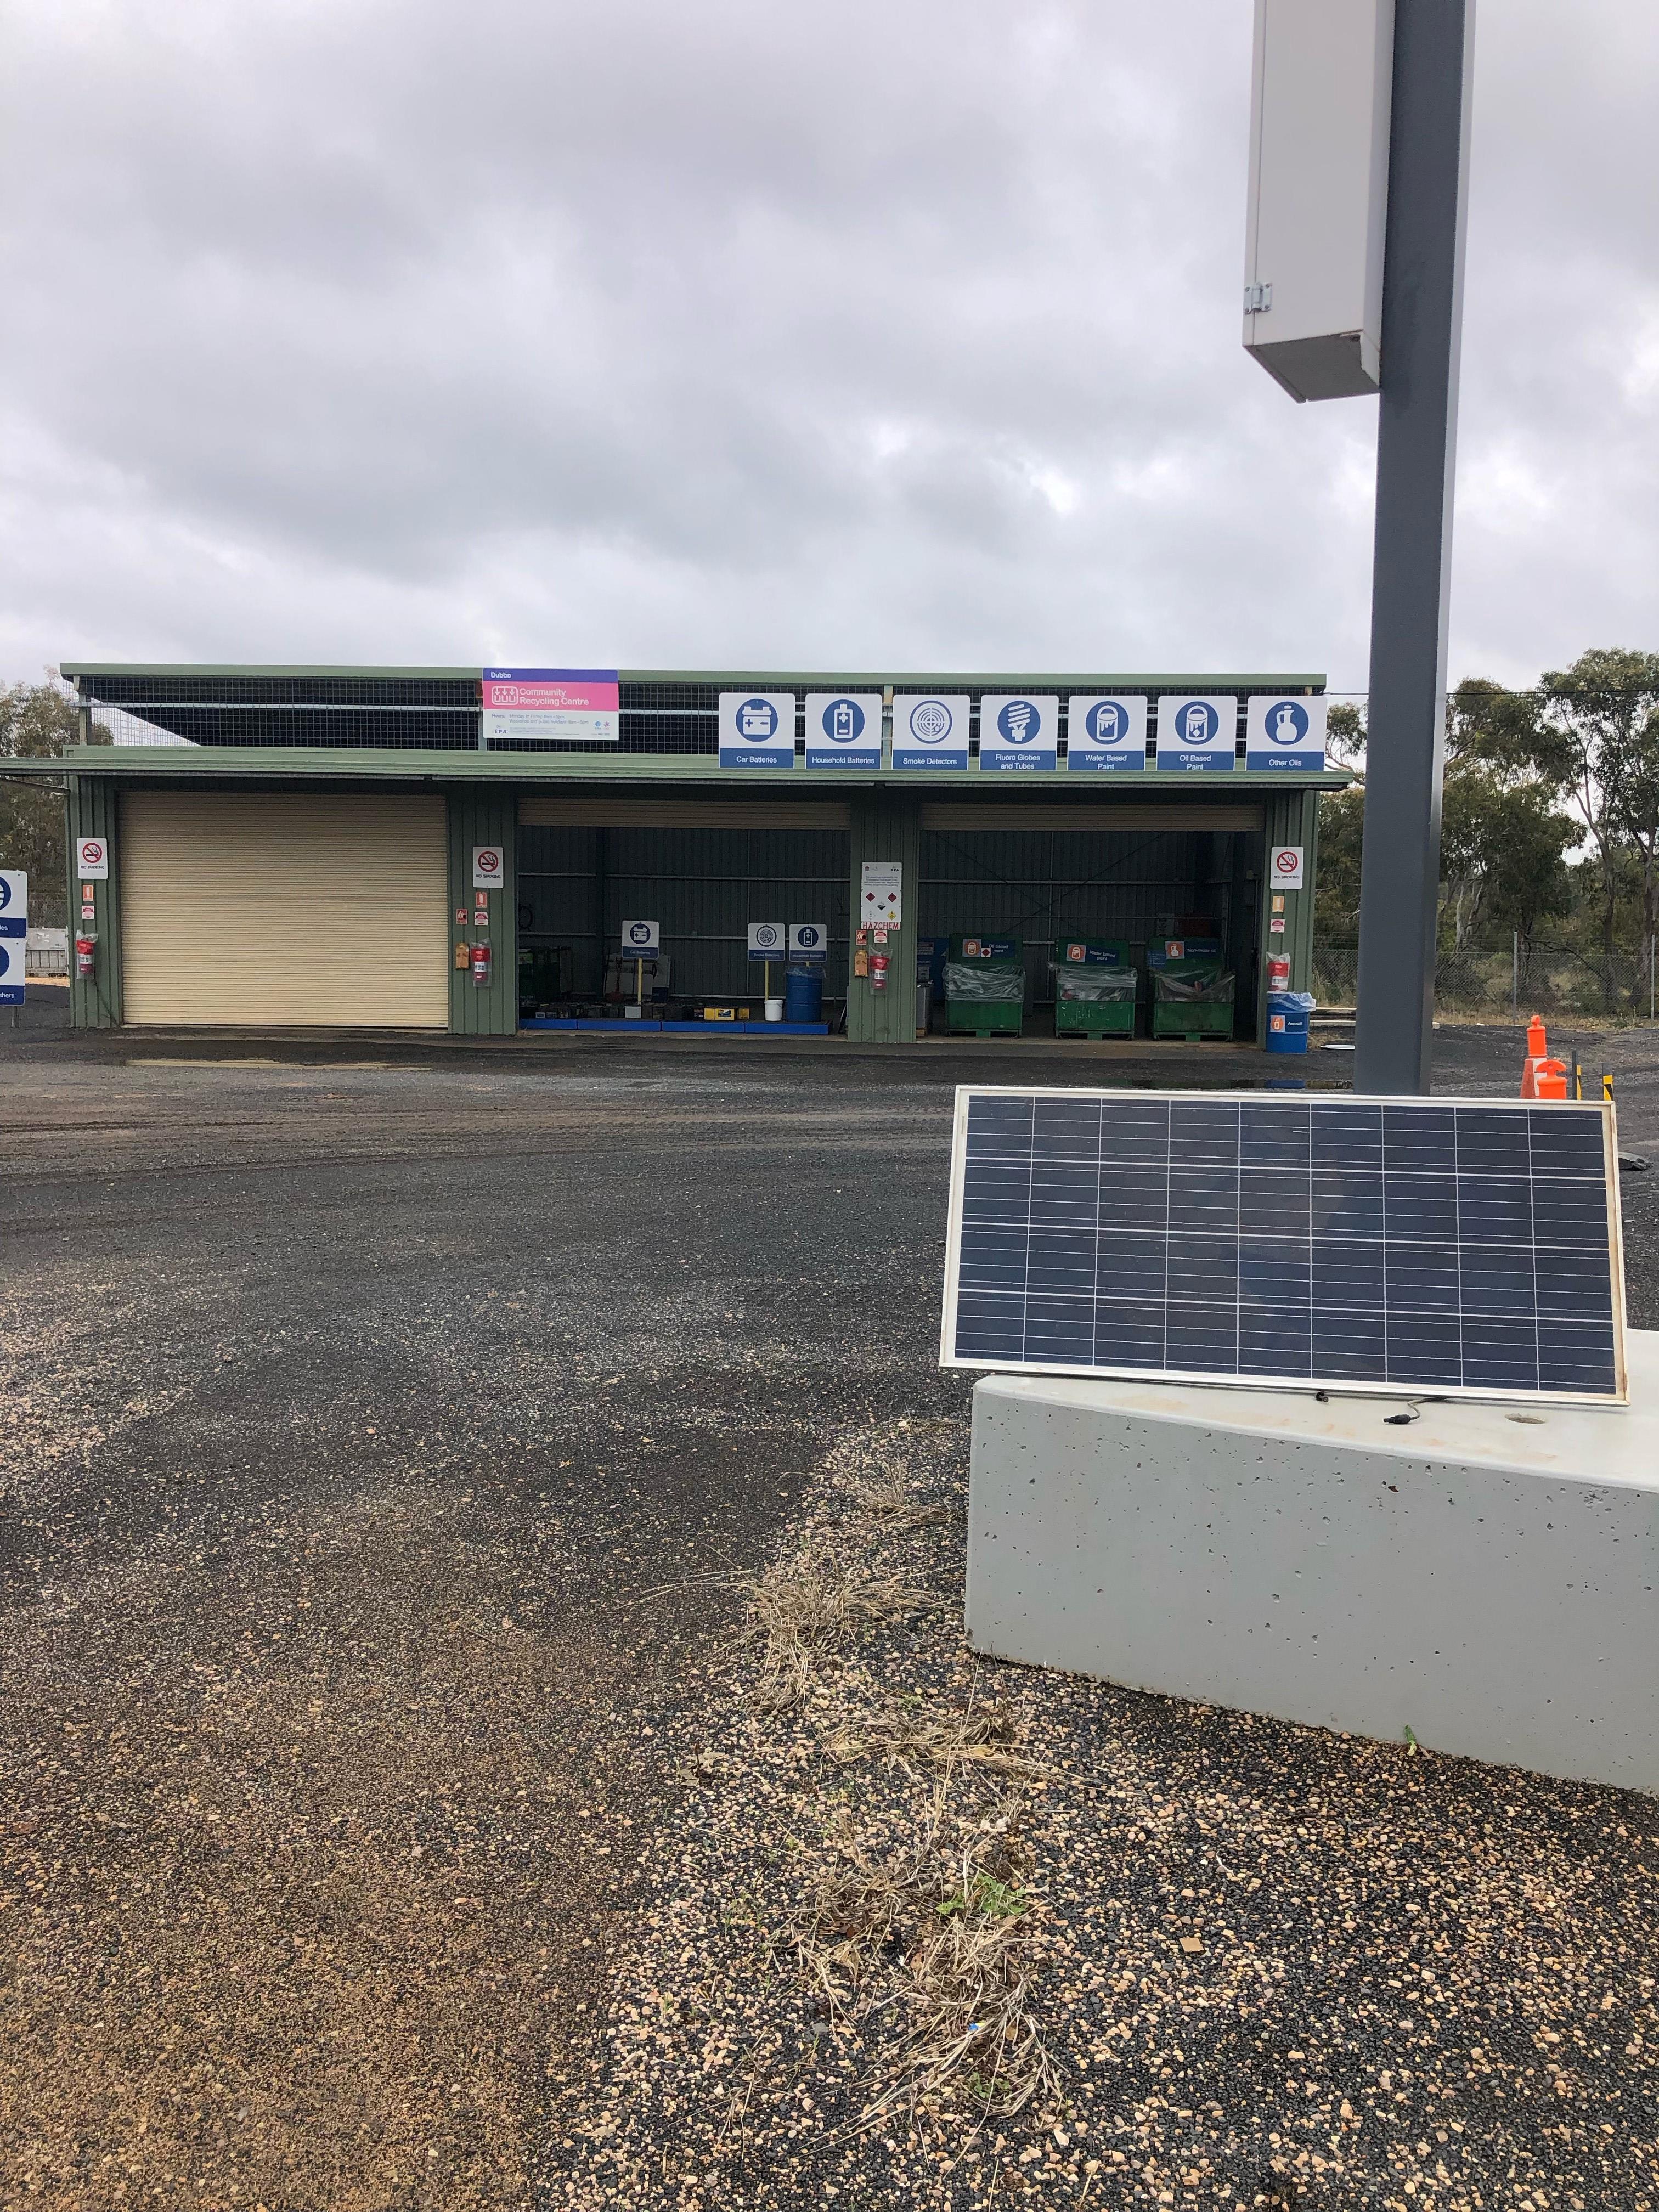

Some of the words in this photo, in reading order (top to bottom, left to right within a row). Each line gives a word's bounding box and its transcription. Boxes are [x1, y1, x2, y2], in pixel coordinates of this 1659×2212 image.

[520, 687, 566, 698] Community
[520, 697, 559, 706] Recycling
[561, 697, 589, 706] Centre
[863, 922, 899, 930] HAZCHEM
